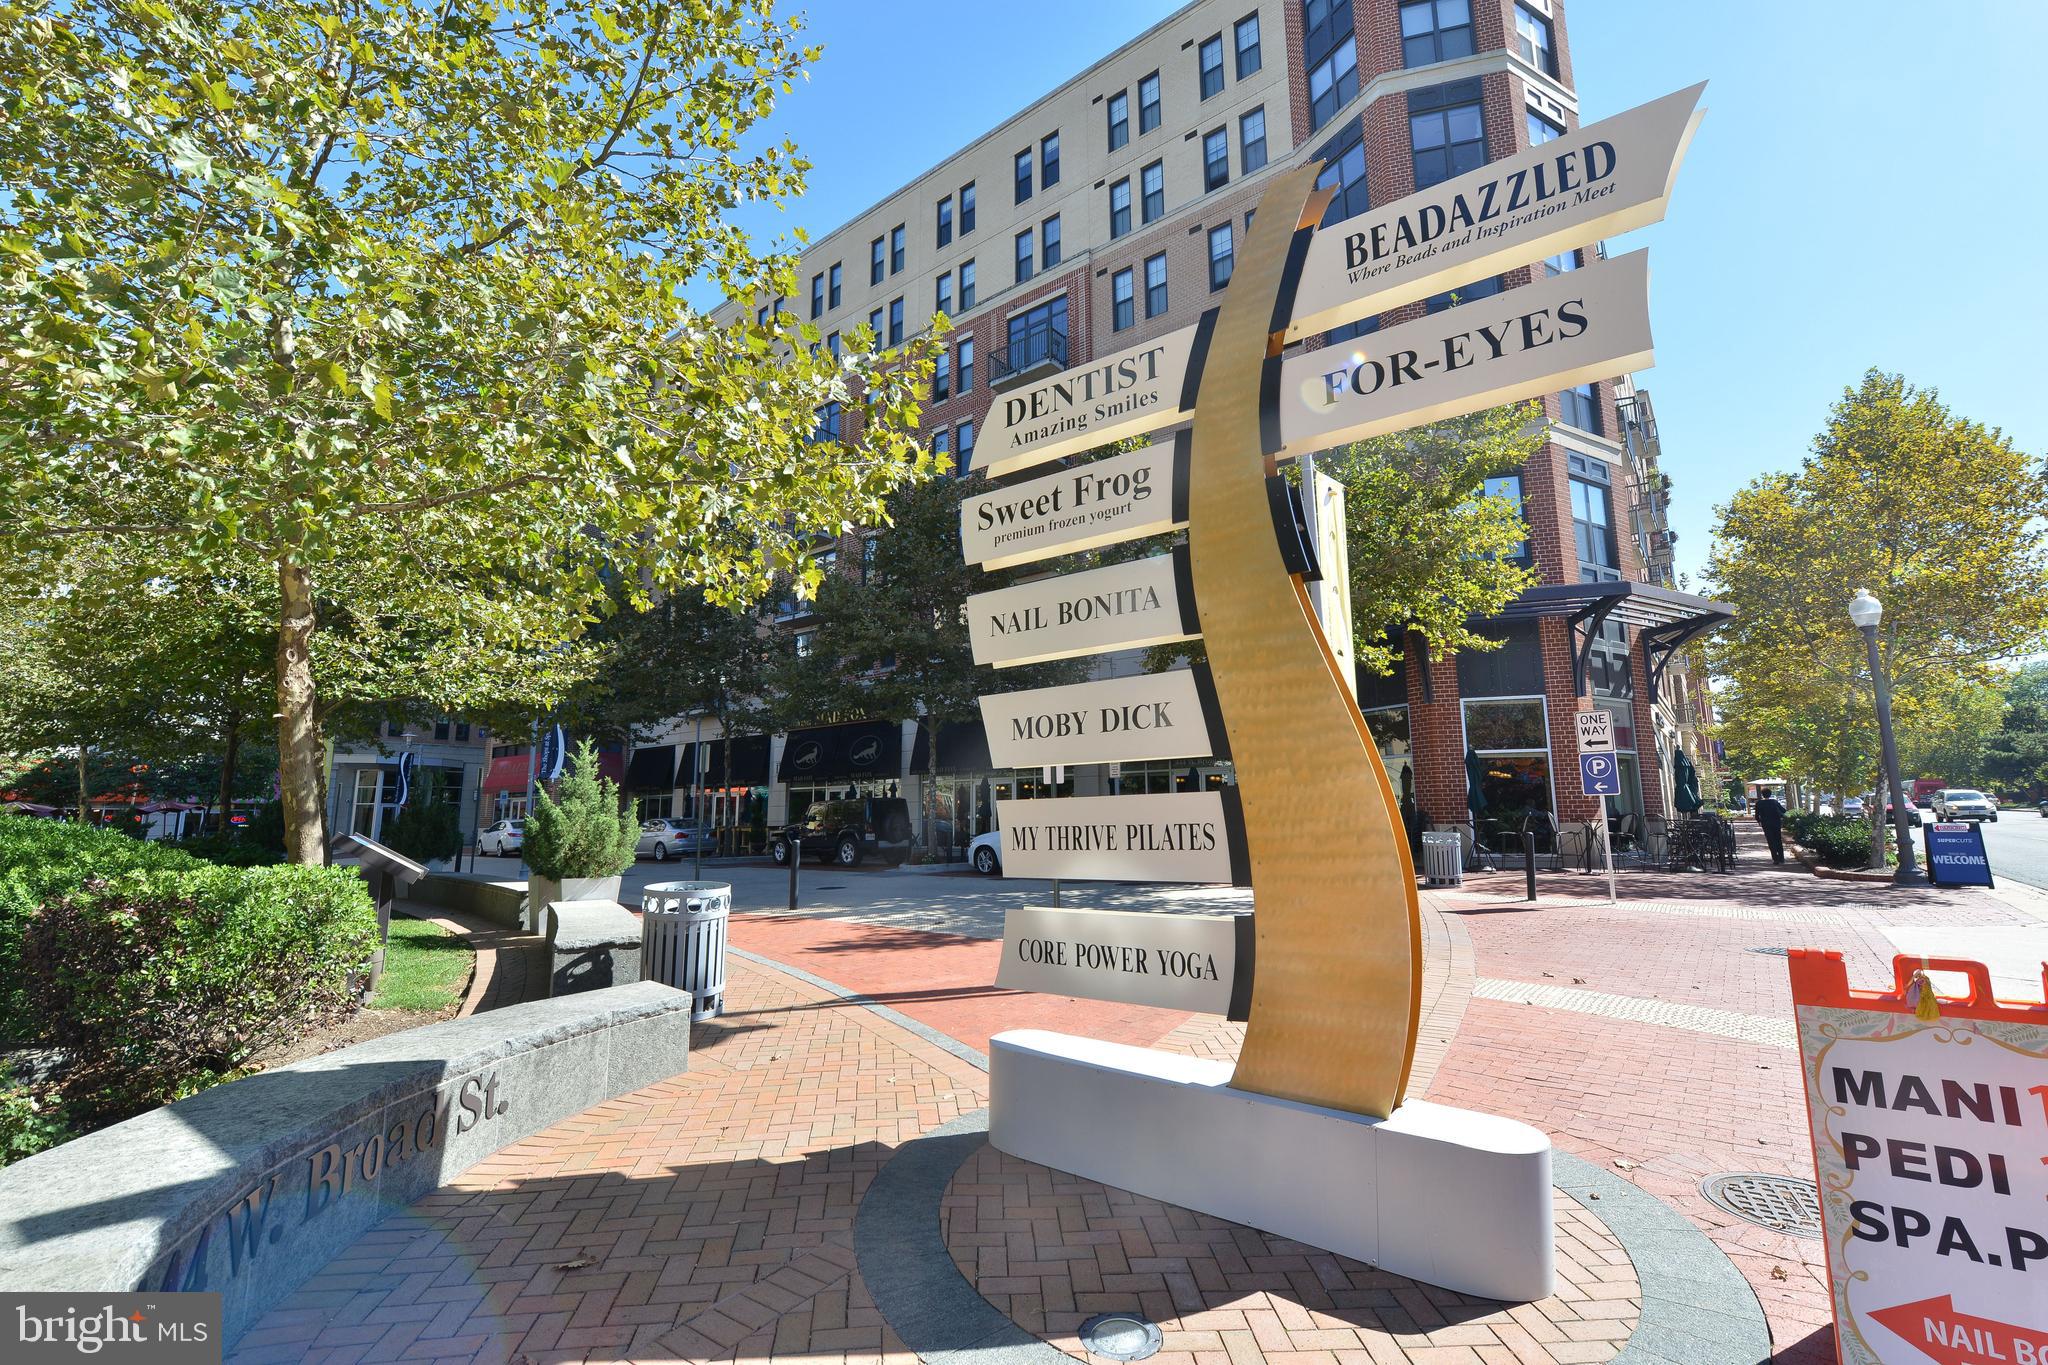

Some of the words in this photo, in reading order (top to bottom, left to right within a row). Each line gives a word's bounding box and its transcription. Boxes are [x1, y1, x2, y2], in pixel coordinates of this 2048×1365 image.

[1344, 140, 1617, 270] BEADAZZLED
[1347, 260, 1392, 286] Where
[1395, 244, 1437, 271] Beads
[1441, 230, 1472, 255] and
[1475, 199, 1567, 242] Inspiration
[1572, 181, 1617, 209] Meet
[1321, 298, 1589, 406] FOR-EYES
[1004, 346, 1165, 429] DENTIST
[1009, 412, 1088, 449] Amazing
[1094, 390, 1159, 422] Smiles
[977, 483, 1064, 531] Sweet
[1072, 466, 1152, 507] Frog
[993, 522, 1045, 548] premium
[1048, 511, 1086, 530] frozen
[1089, 502, 1132, 525] yogurt
[989, 606, 1048, 637] NAIL
[1057, 585, 1163, 626] BONITA
[1012, 710, 1089, 741] MOBY
[1099, 701, 1175, 733] DICK
[1580, 714, 1607, 724] ONE
[1580, 725, 1608, 736] WAY
[1011, 826, 1039, 851] MY
[1045, 824, 1118, 851] THRIVE
[1126, 822, 1216, 851] PILATES
[1933, 855, 1986, 865] WELCOME
[1018, 938, 1068, 966] CORE
[1075, 942, 1148, 975] POWER
[1155, 949, 1220, 981] YOGA
[1831, 1066, 2023, 1127] MANI
[300, 1092, 446, 1226] Broad
[456, 1069, 510, 1136] St.
[1840, 1131, 2012, 1196] PEDI
[1923, 1317, 2006, 1361] NAIL
